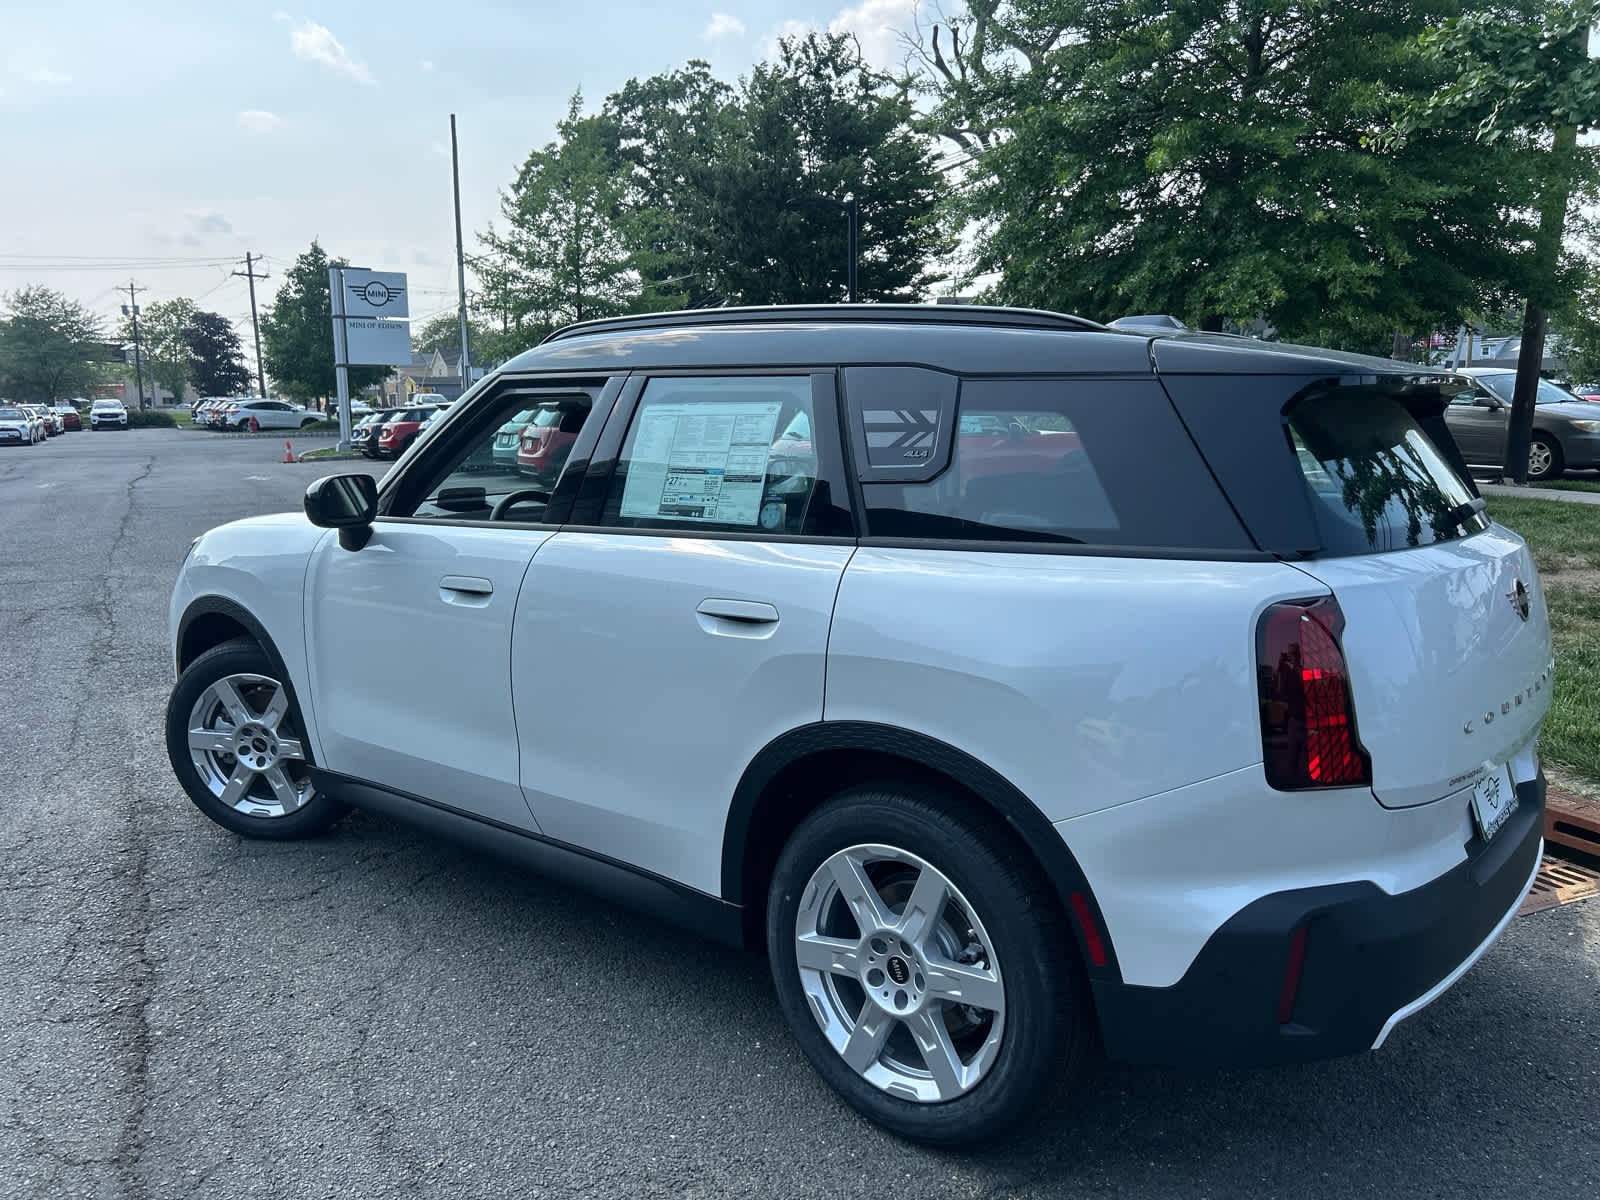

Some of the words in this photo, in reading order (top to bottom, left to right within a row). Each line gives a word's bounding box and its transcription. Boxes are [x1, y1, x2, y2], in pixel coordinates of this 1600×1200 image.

[367, 289, 387, 298] MINI
[349, 321, 366, 329] MINI
[367, 321, 377, 329] OF
[892, 958, 904, 980] MINI
